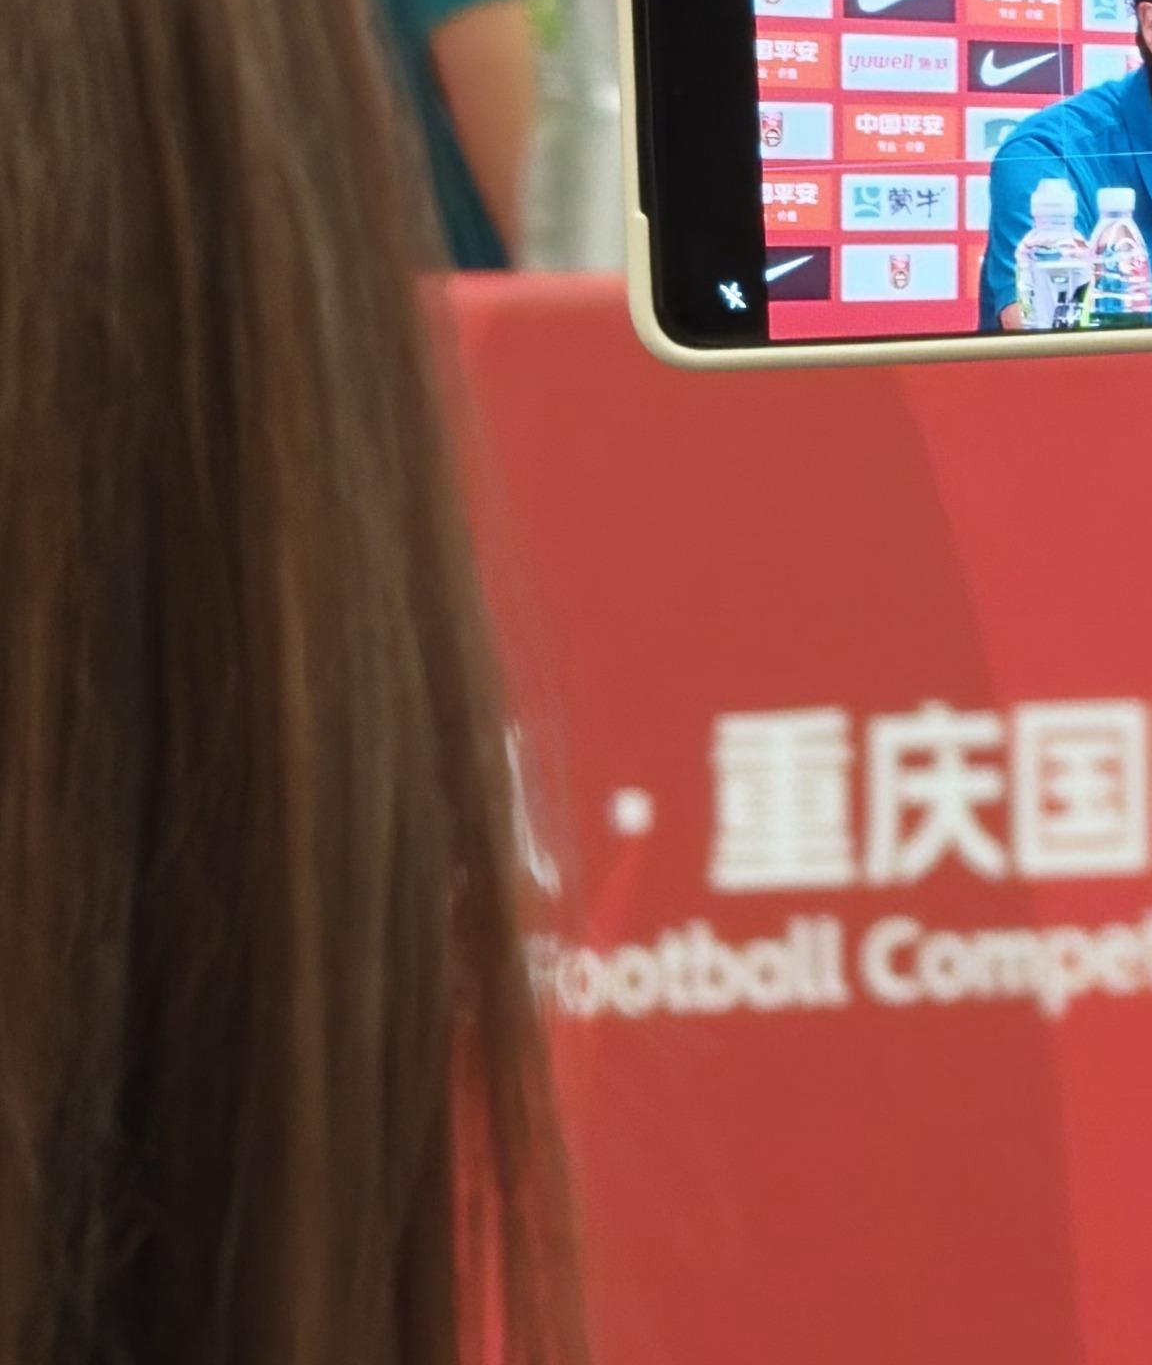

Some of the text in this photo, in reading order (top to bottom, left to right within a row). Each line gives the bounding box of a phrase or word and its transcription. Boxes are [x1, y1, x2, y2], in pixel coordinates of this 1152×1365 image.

[849, 54, 913, 72] yuwell
[856, 114, 944, 136] 中国平安
[888, 187, 940, 217] 蒙牛
